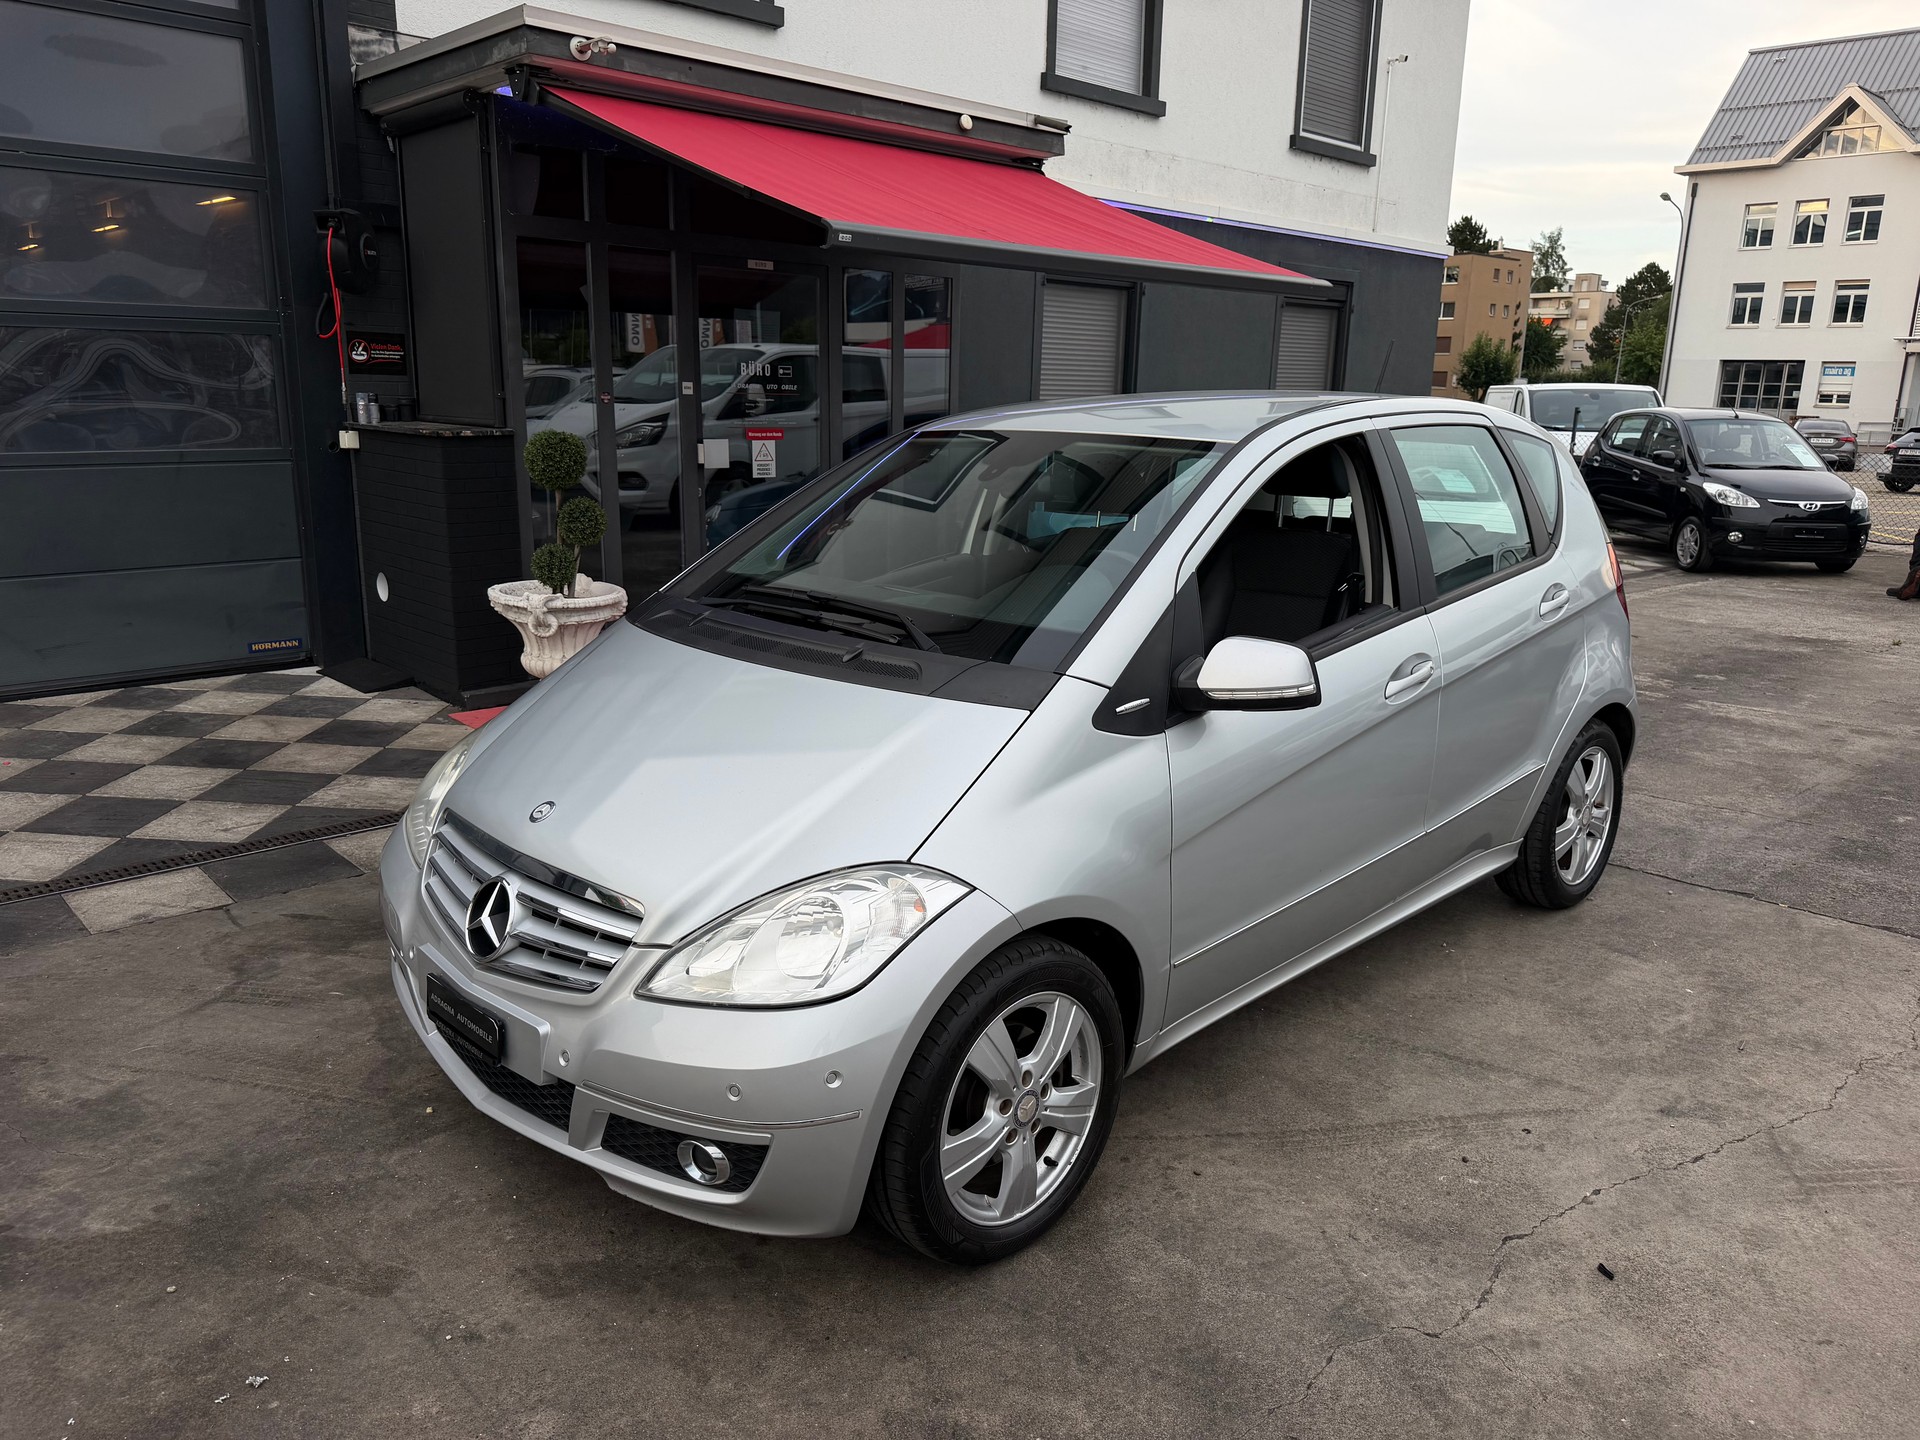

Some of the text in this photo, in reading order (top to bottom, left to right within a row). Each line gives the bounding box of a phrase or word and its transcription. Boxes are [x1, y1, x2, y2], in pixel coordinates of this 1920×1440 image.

[740, 361, 771, 377] BÜRO
[430, 993, 493, 1044] ADRAGNA AUTOMOBILE
